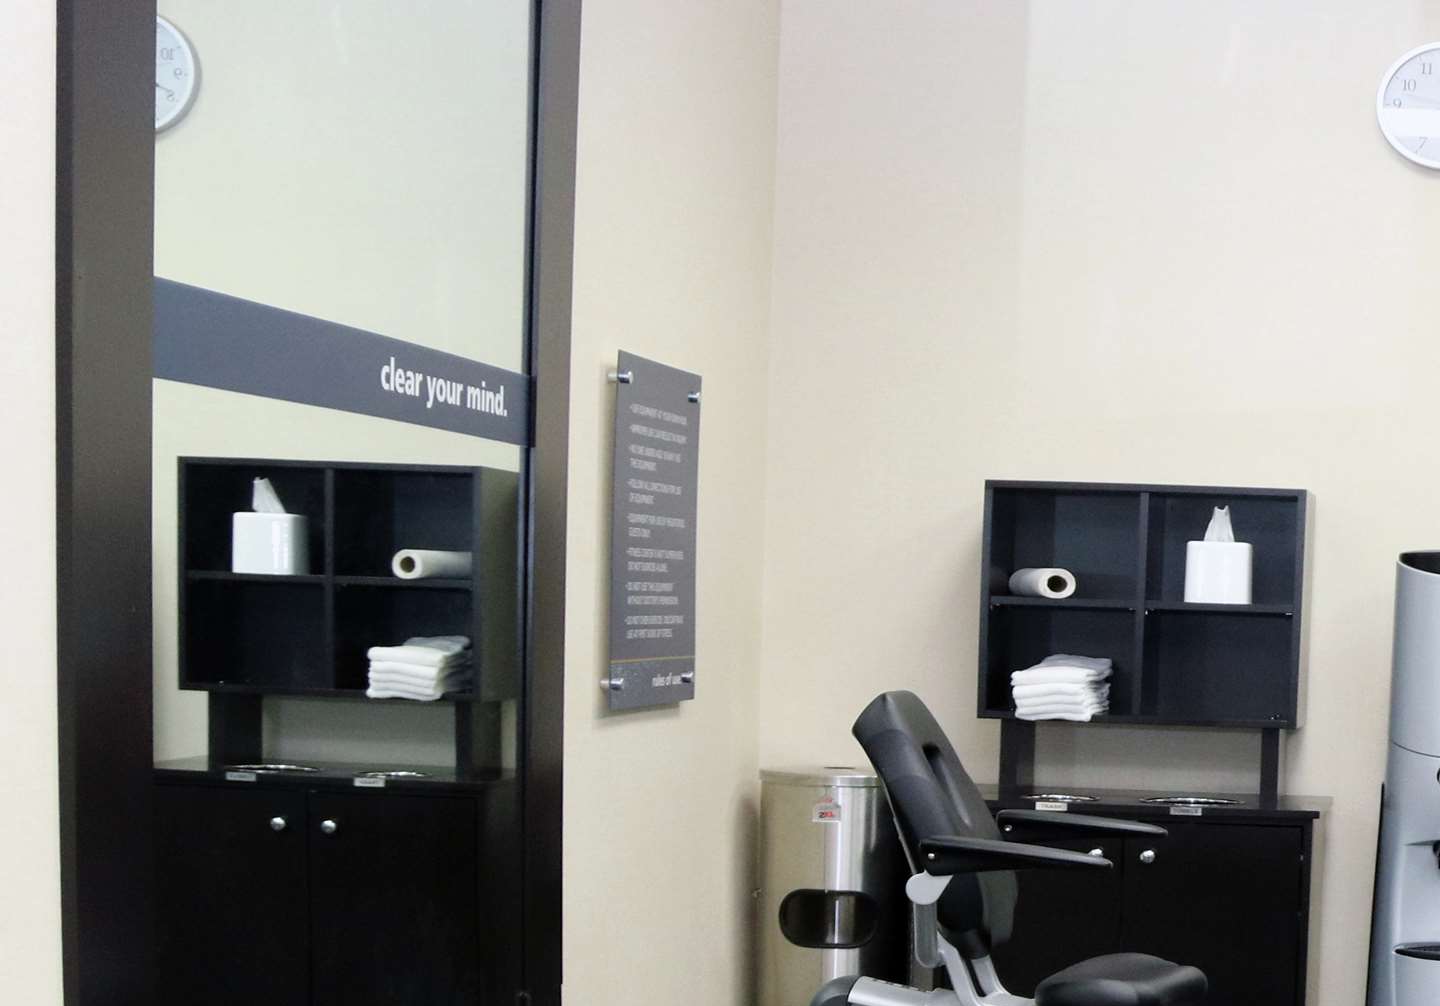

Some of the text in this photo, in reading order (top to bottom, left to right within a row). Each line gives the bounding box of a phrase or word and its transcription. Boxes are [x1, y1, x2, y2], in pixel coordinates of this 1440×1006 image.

[1421, 63, 1432, 75] 11
[1403, 79, 1417, 92] 10
[1392, 98, 1402, 108] 9
[1419, 136, 1428, 149] 7
[380, 356, 508, 417] clear your mind.
